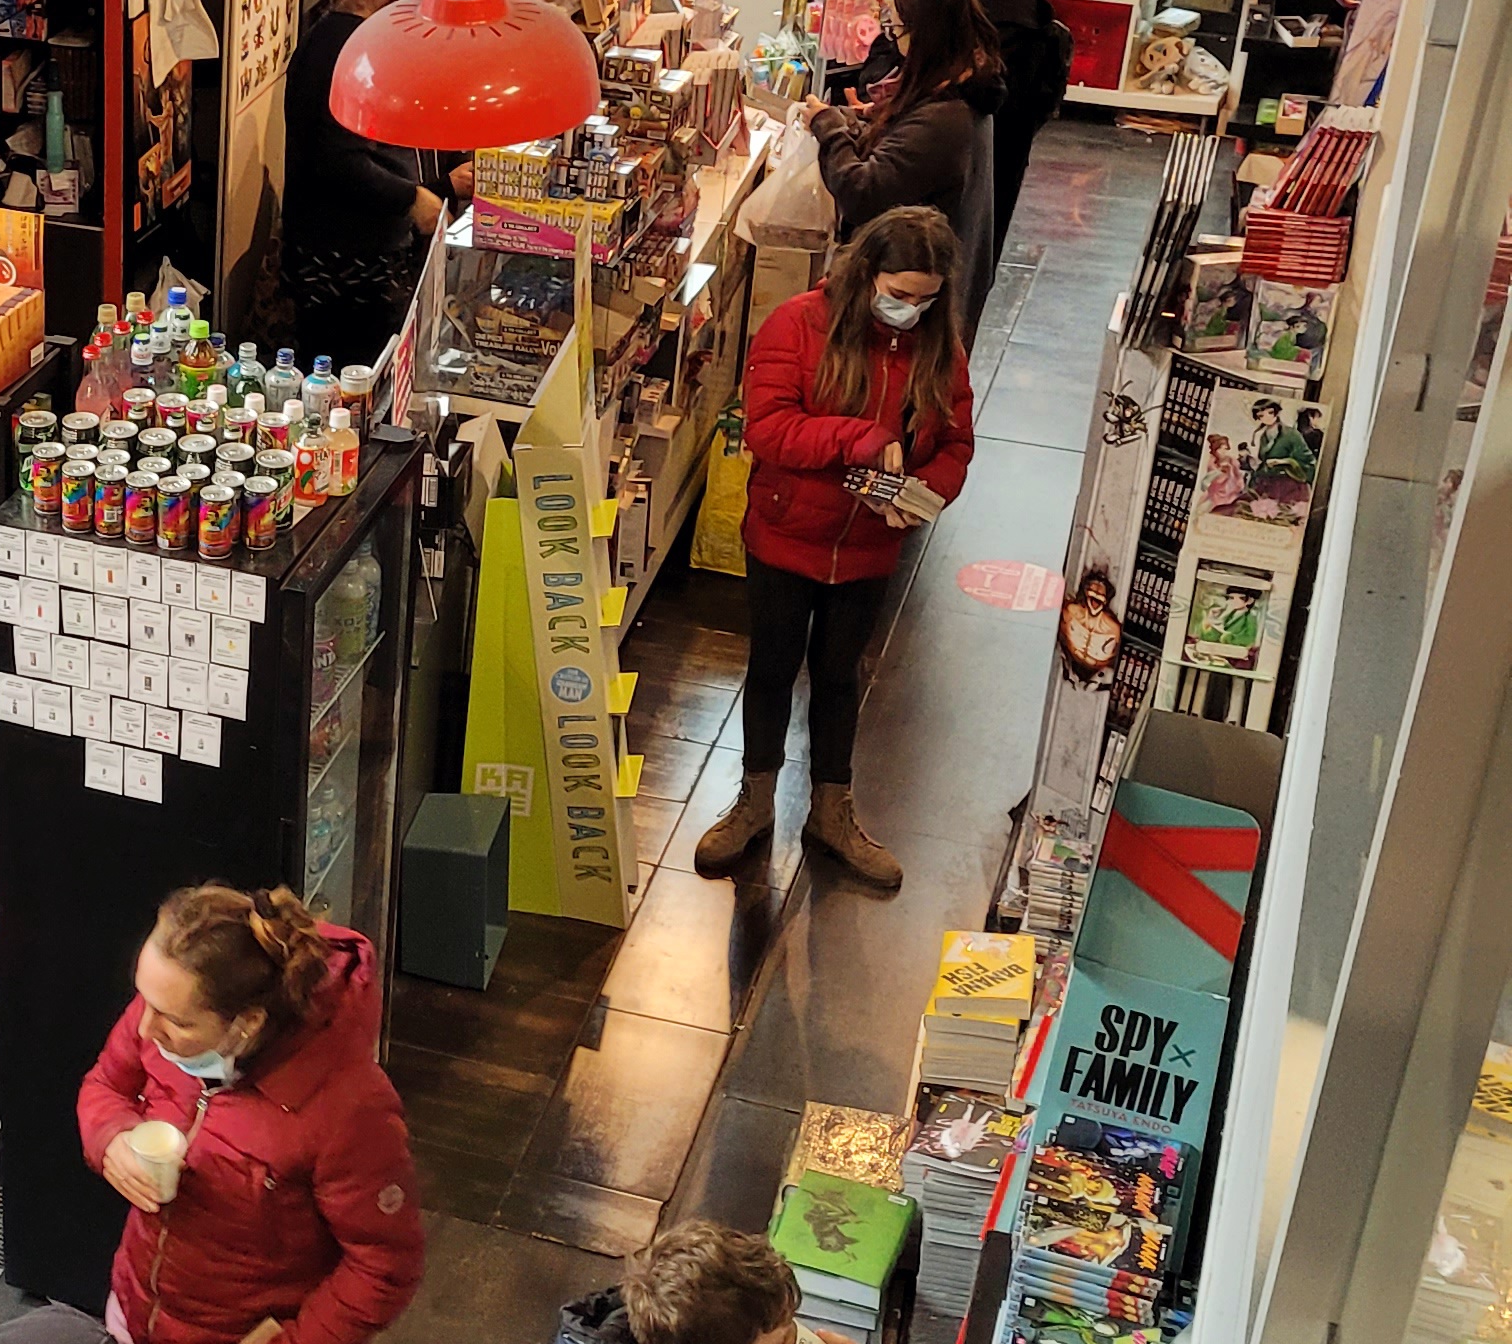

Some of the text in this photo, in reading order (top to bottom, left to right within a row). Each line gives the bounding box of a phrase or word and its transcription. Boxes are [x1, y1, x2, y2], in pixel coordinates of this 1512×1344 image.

[531, 473, 580, 558] LOOK
[542, 570, 591, 655] BACK
[557, 714, 603, 793] LOOK
[567, 806, 612, 885] BACK
[942, 962, 989, 985] FISH
[952, 963, 1028, 996] BANANA
[1094, 1004, 1179, 1067] SPY
[1059, 1045, 1199, 1125] FAMILY
[1070, 1098, 1173, 1134] TATSUYA ENDO
